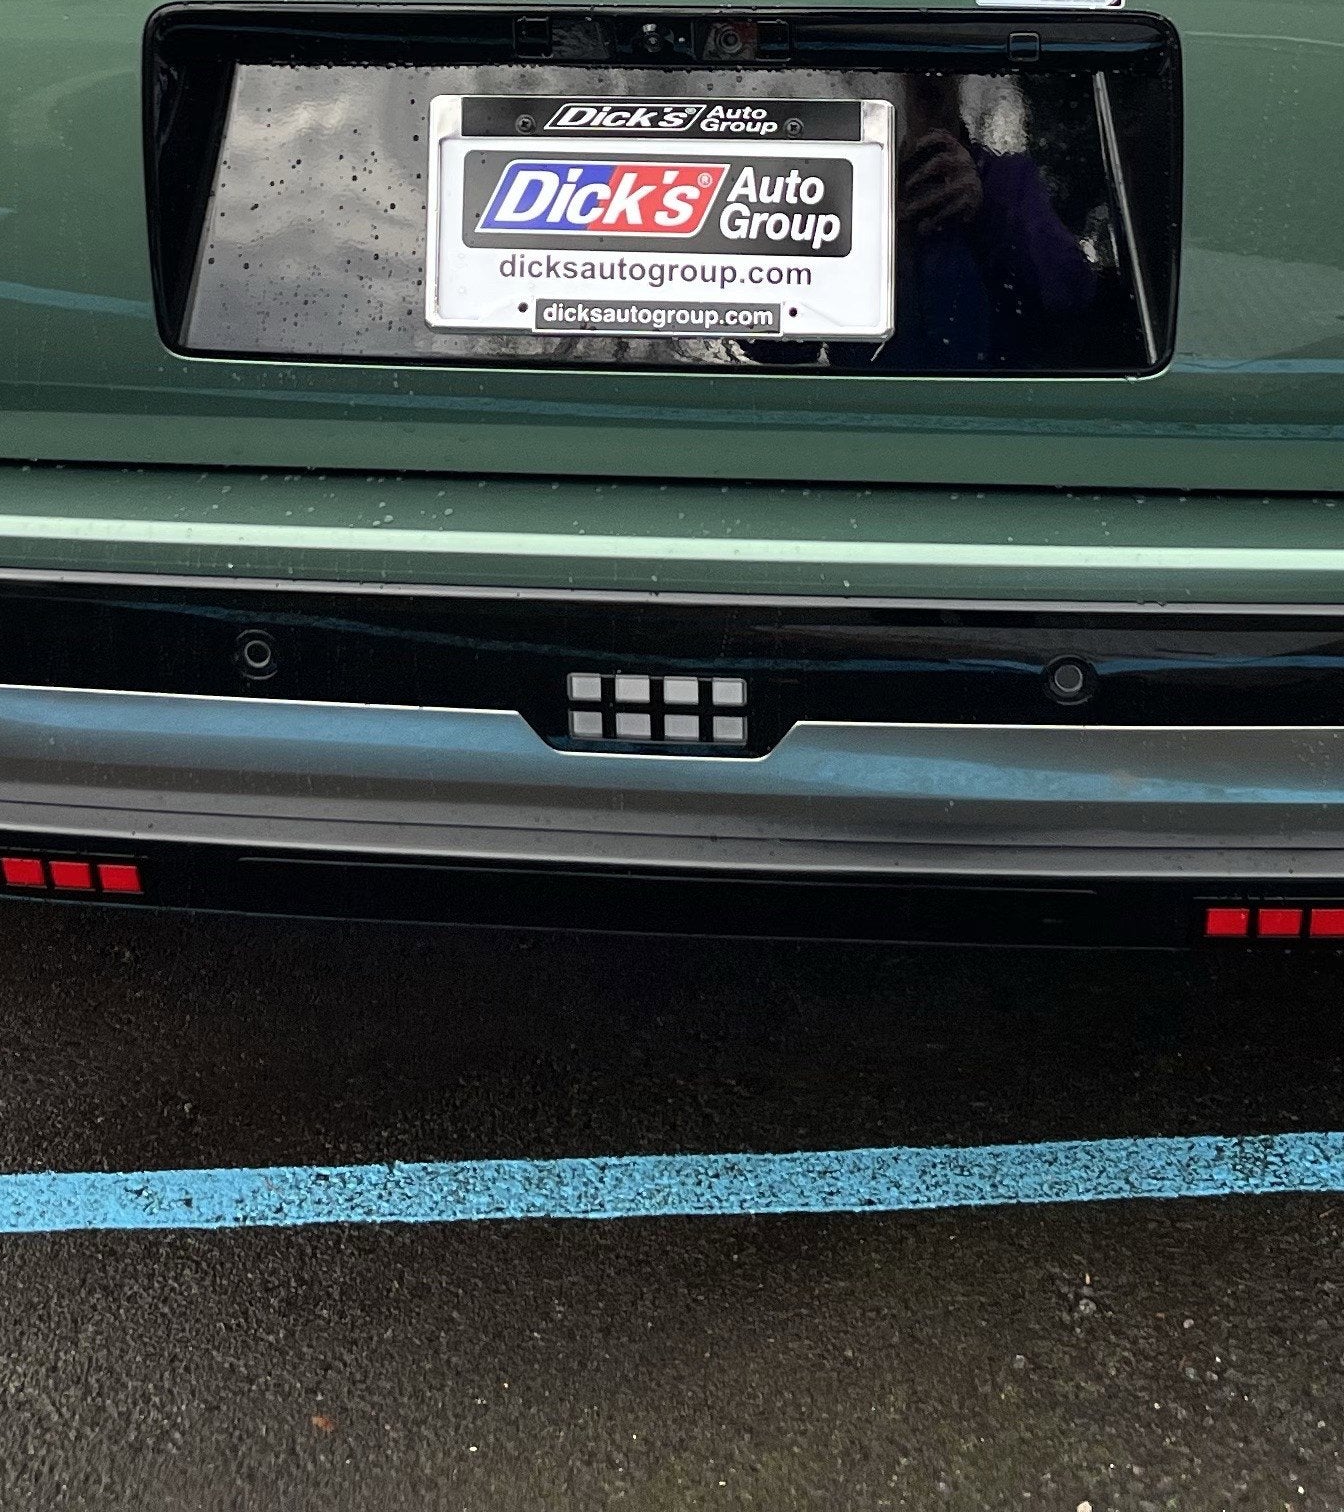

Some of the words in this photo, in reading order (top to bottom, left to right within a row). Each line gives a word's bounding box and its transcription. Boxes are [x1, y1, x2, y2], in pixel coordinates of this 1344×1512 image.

[556, 105, 689, 128] Dick's
[700, 118, 778, 136] Group
[706, 105, 768, 120] Auto
[493, 168, 701, 227] Dick's
[726, 166, 825, 205] Auto
[719, 202, 841, 250] Group
[499, 254, 812, 289] dicksautogroup.com
[542, 303, 774, 328] dicksautogroup.com
